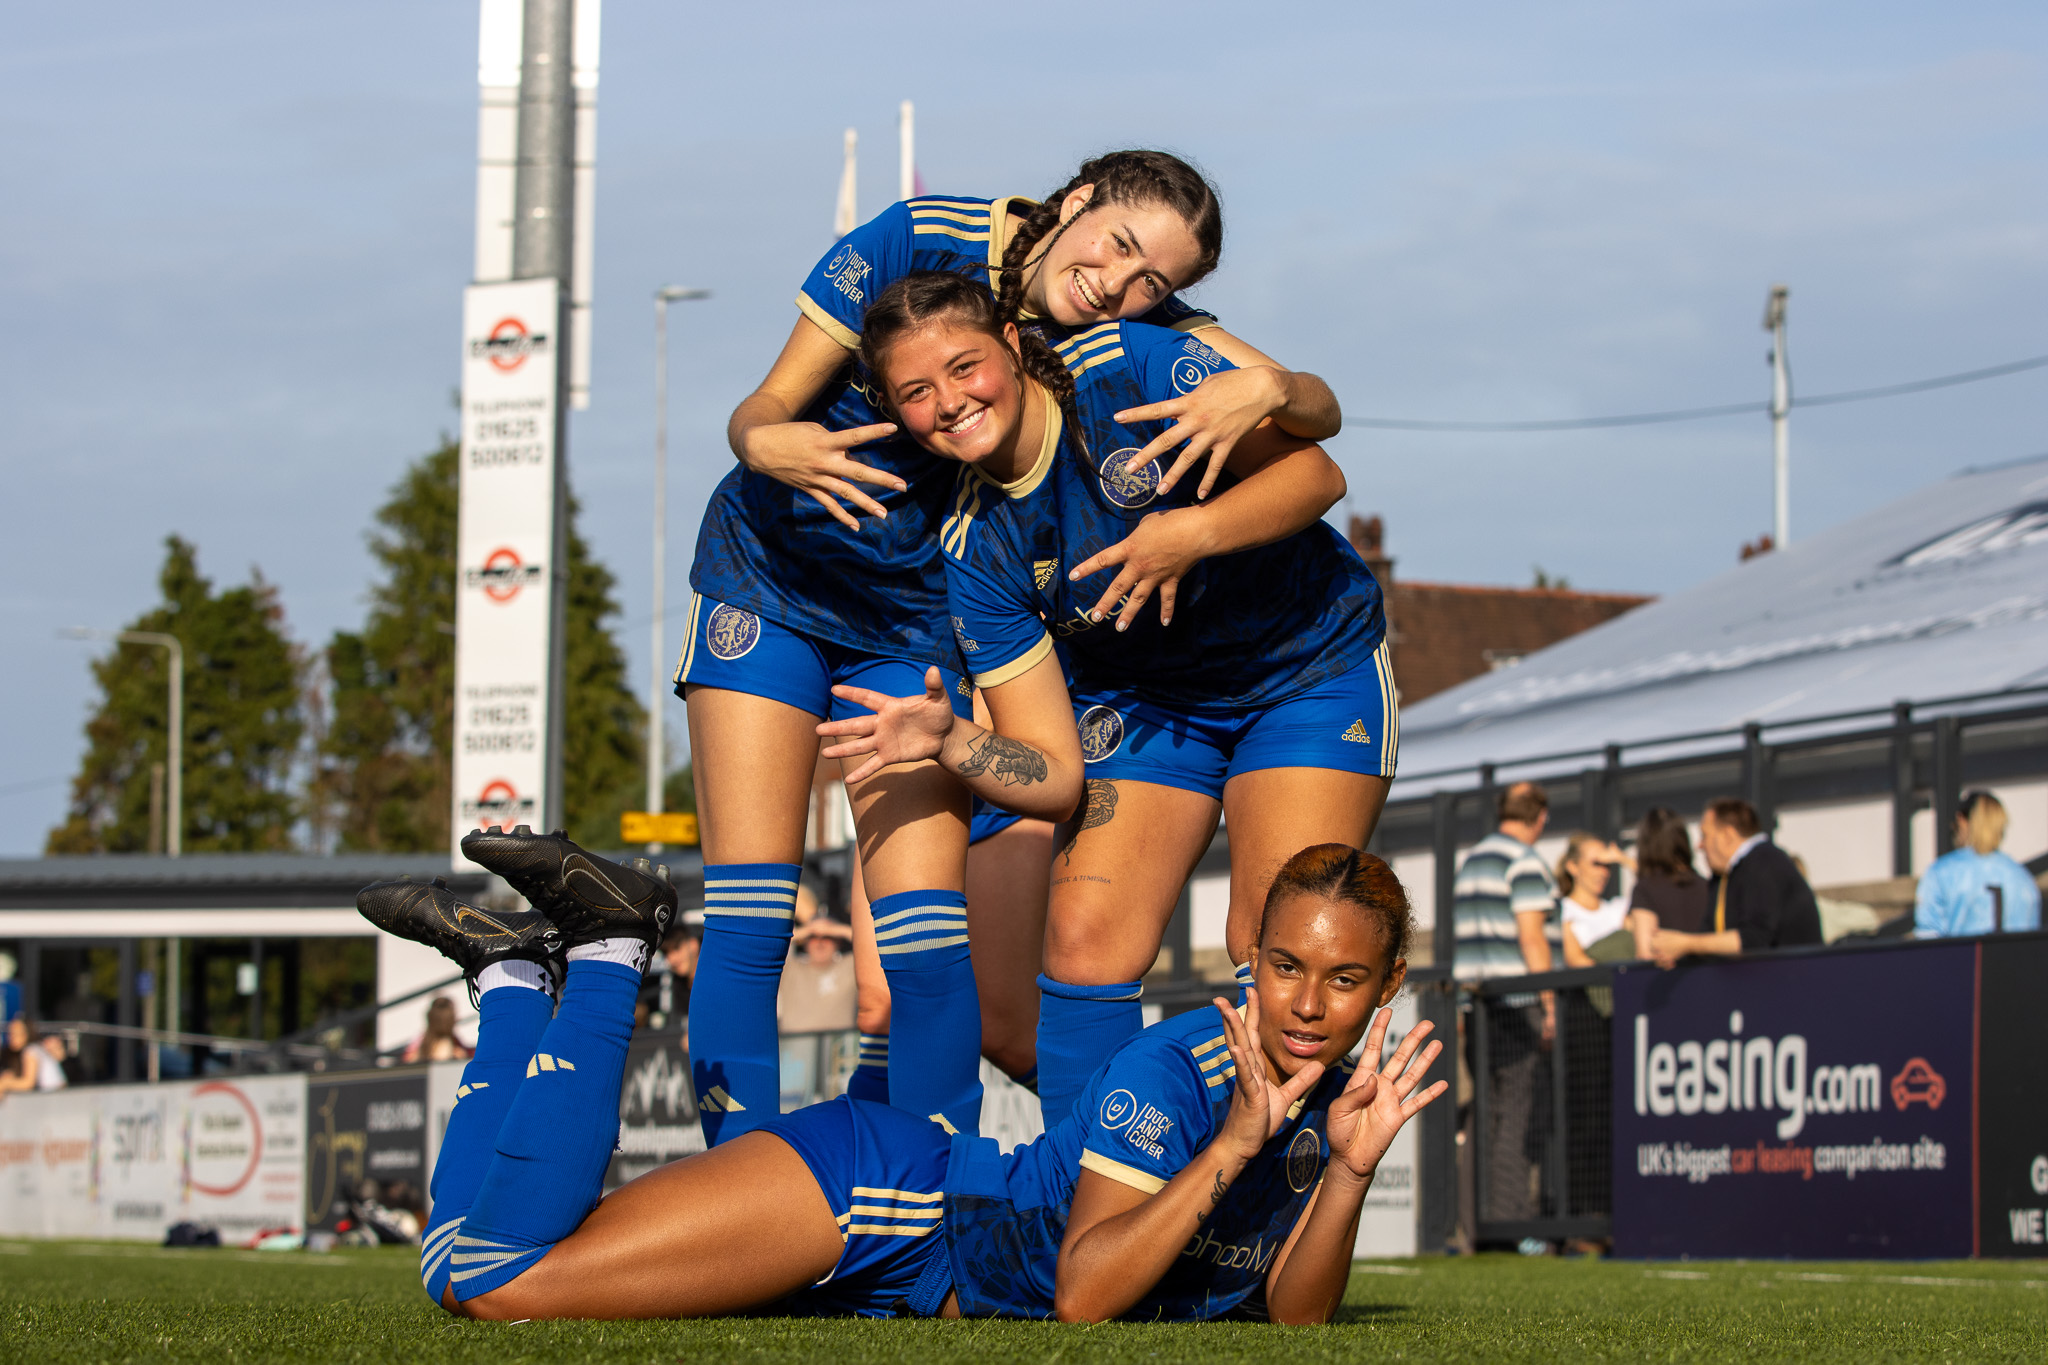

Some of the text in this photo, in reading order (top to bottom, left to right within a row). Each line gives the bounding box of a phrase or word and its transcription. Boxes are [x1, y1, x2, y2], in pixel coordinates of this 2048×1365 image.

[833, 275, 864, 304] COVER
[841, 265, 861, 285] AND
[1037, 557, 1059, 590] adidas
[749, 625, 757, 635] FC
[1341, 733, 1371, 744] adidas
[1634, 1010, 1881, 1140] leasing.com
[1136, 1119, 1162, 1141] AND
[1128, 1130, 1164, 1160] COVER
[1638, 1134, 1947, 1183] UK's biggest car leasing comparison site
[2008, 1207, 2045, 1244] WE
